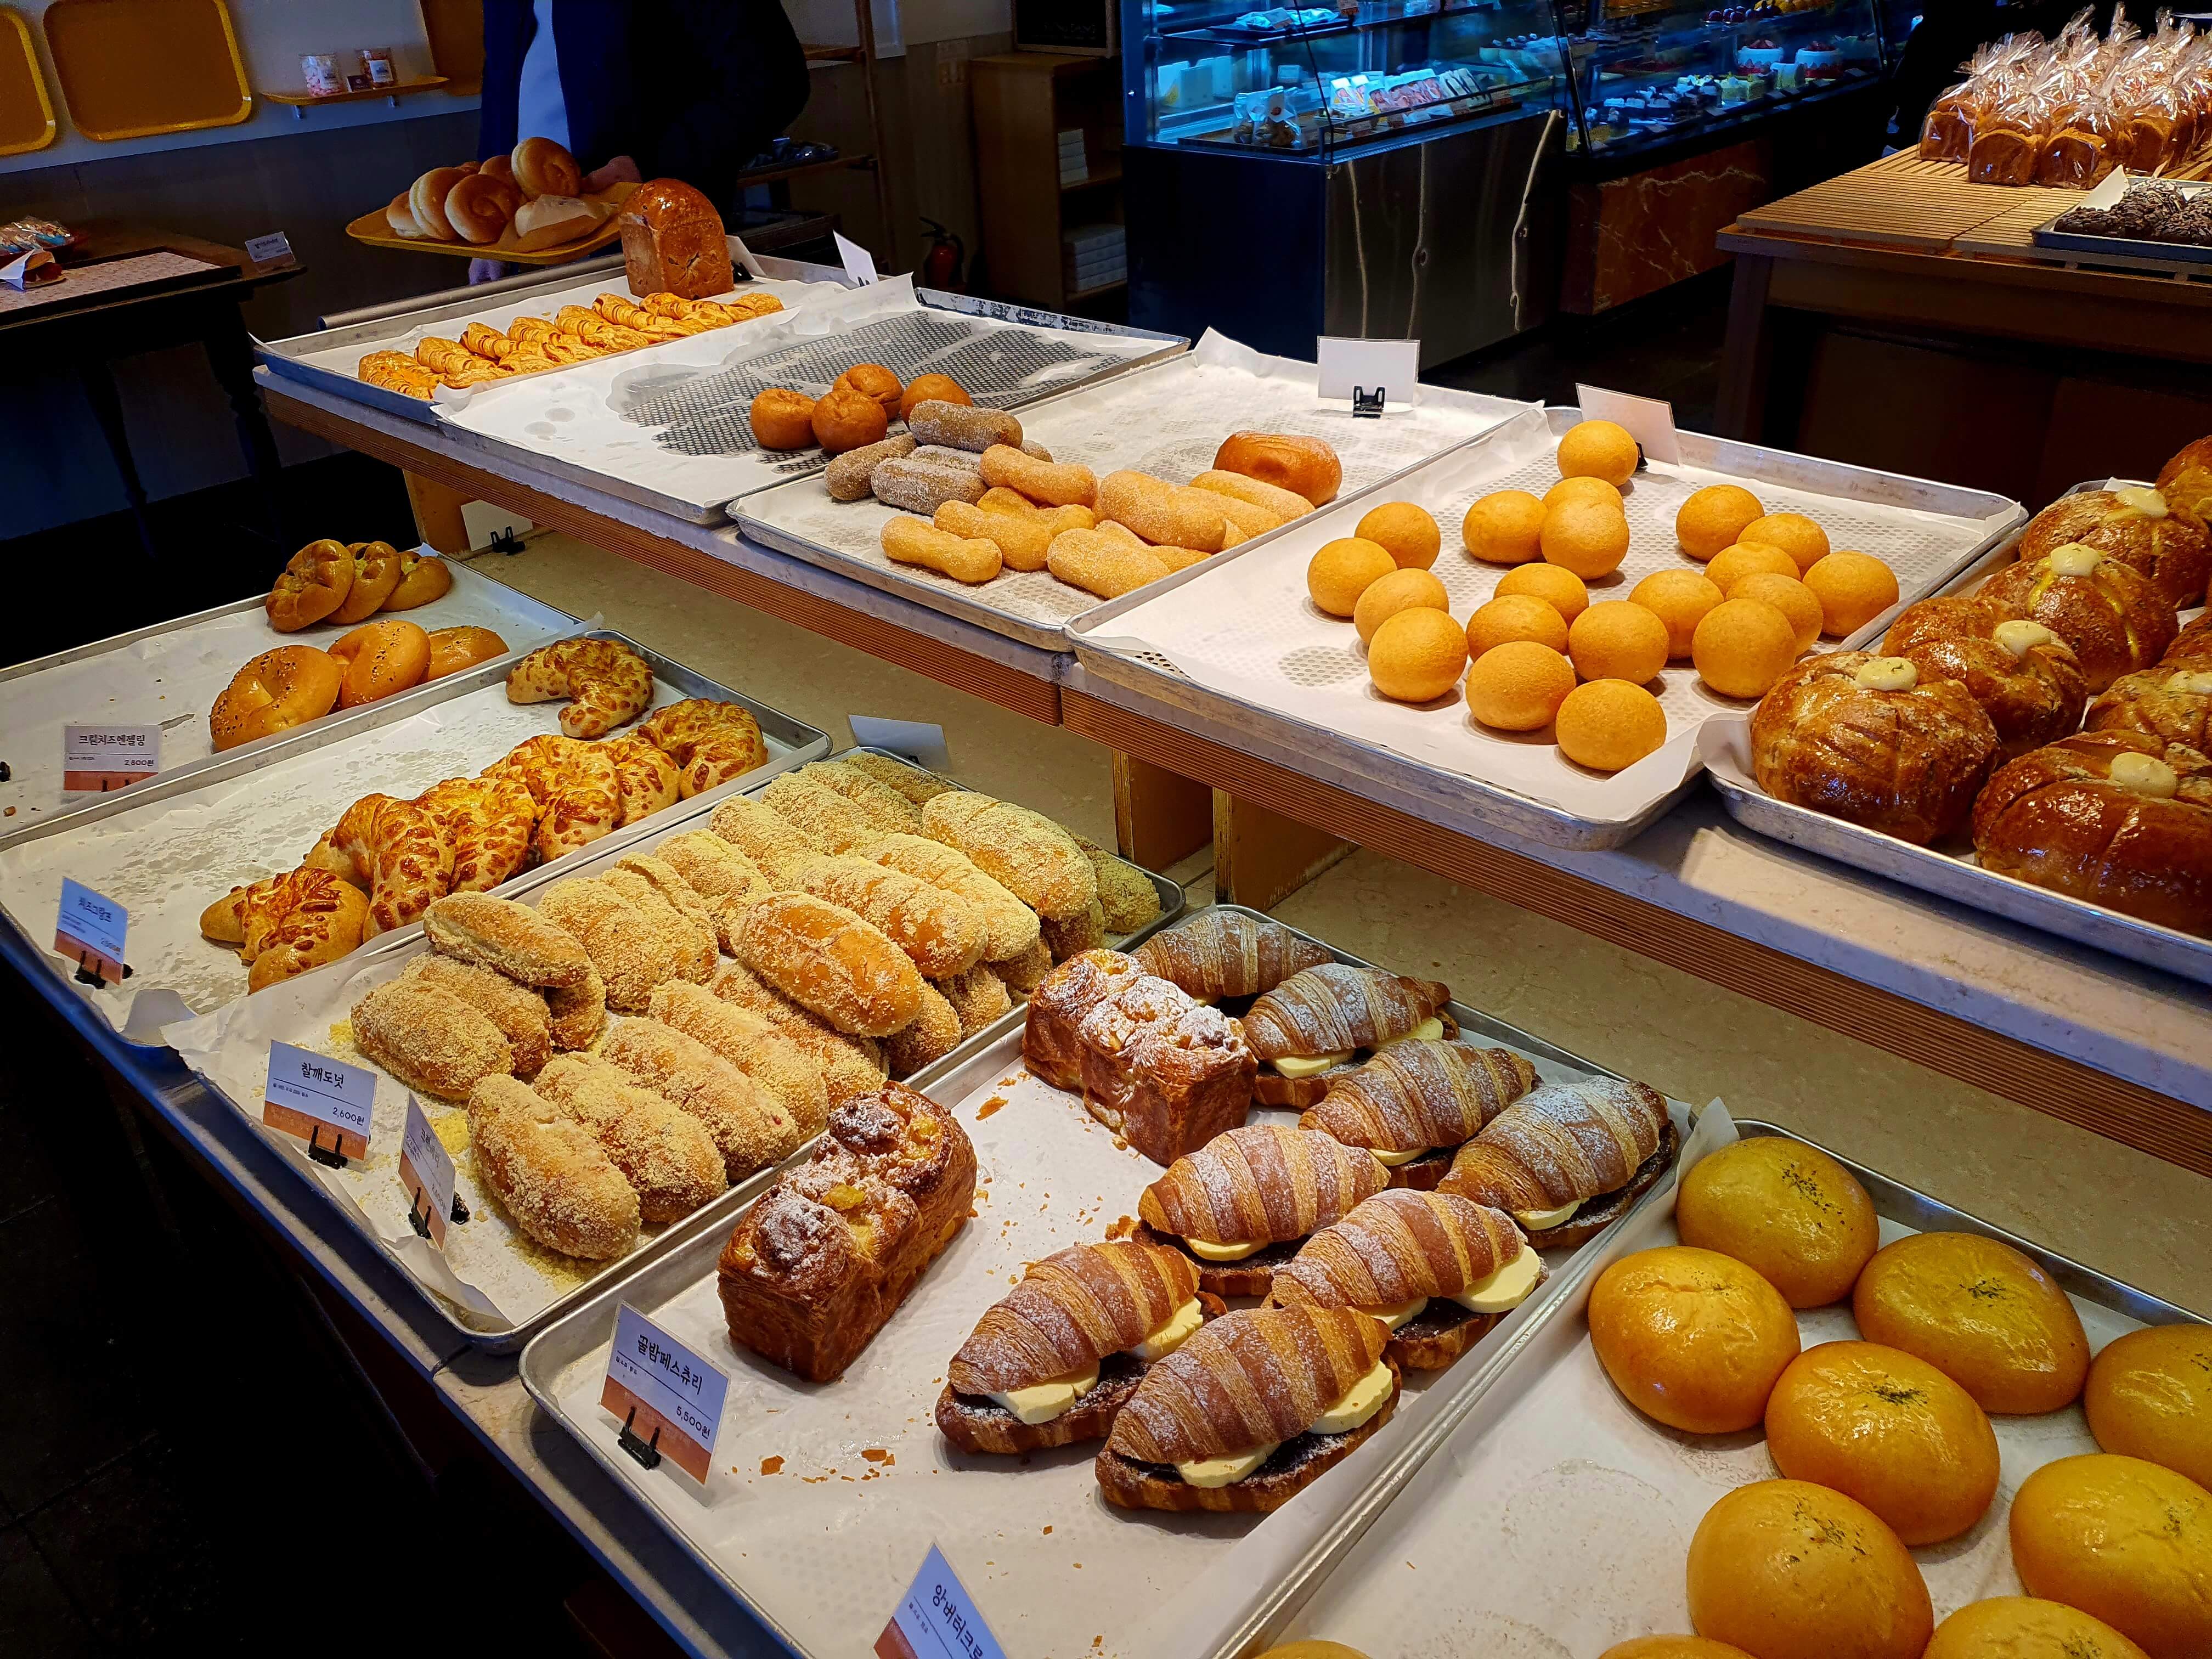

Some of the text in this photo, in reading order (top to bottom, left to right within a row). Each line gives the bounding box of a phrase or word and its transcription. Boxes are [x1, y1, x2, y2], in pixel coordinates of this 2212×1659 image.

[79, 734, 145, 746] 크림치즈엔젤링
[301, 1062, 344, 1089] 찰깨도넛
[332, 1107, 364, 1126] 2,600원
[637, 1334, 703, 1395] 꿀밤페스츄리
[676, 1406, 710, 1440] 5,500원
